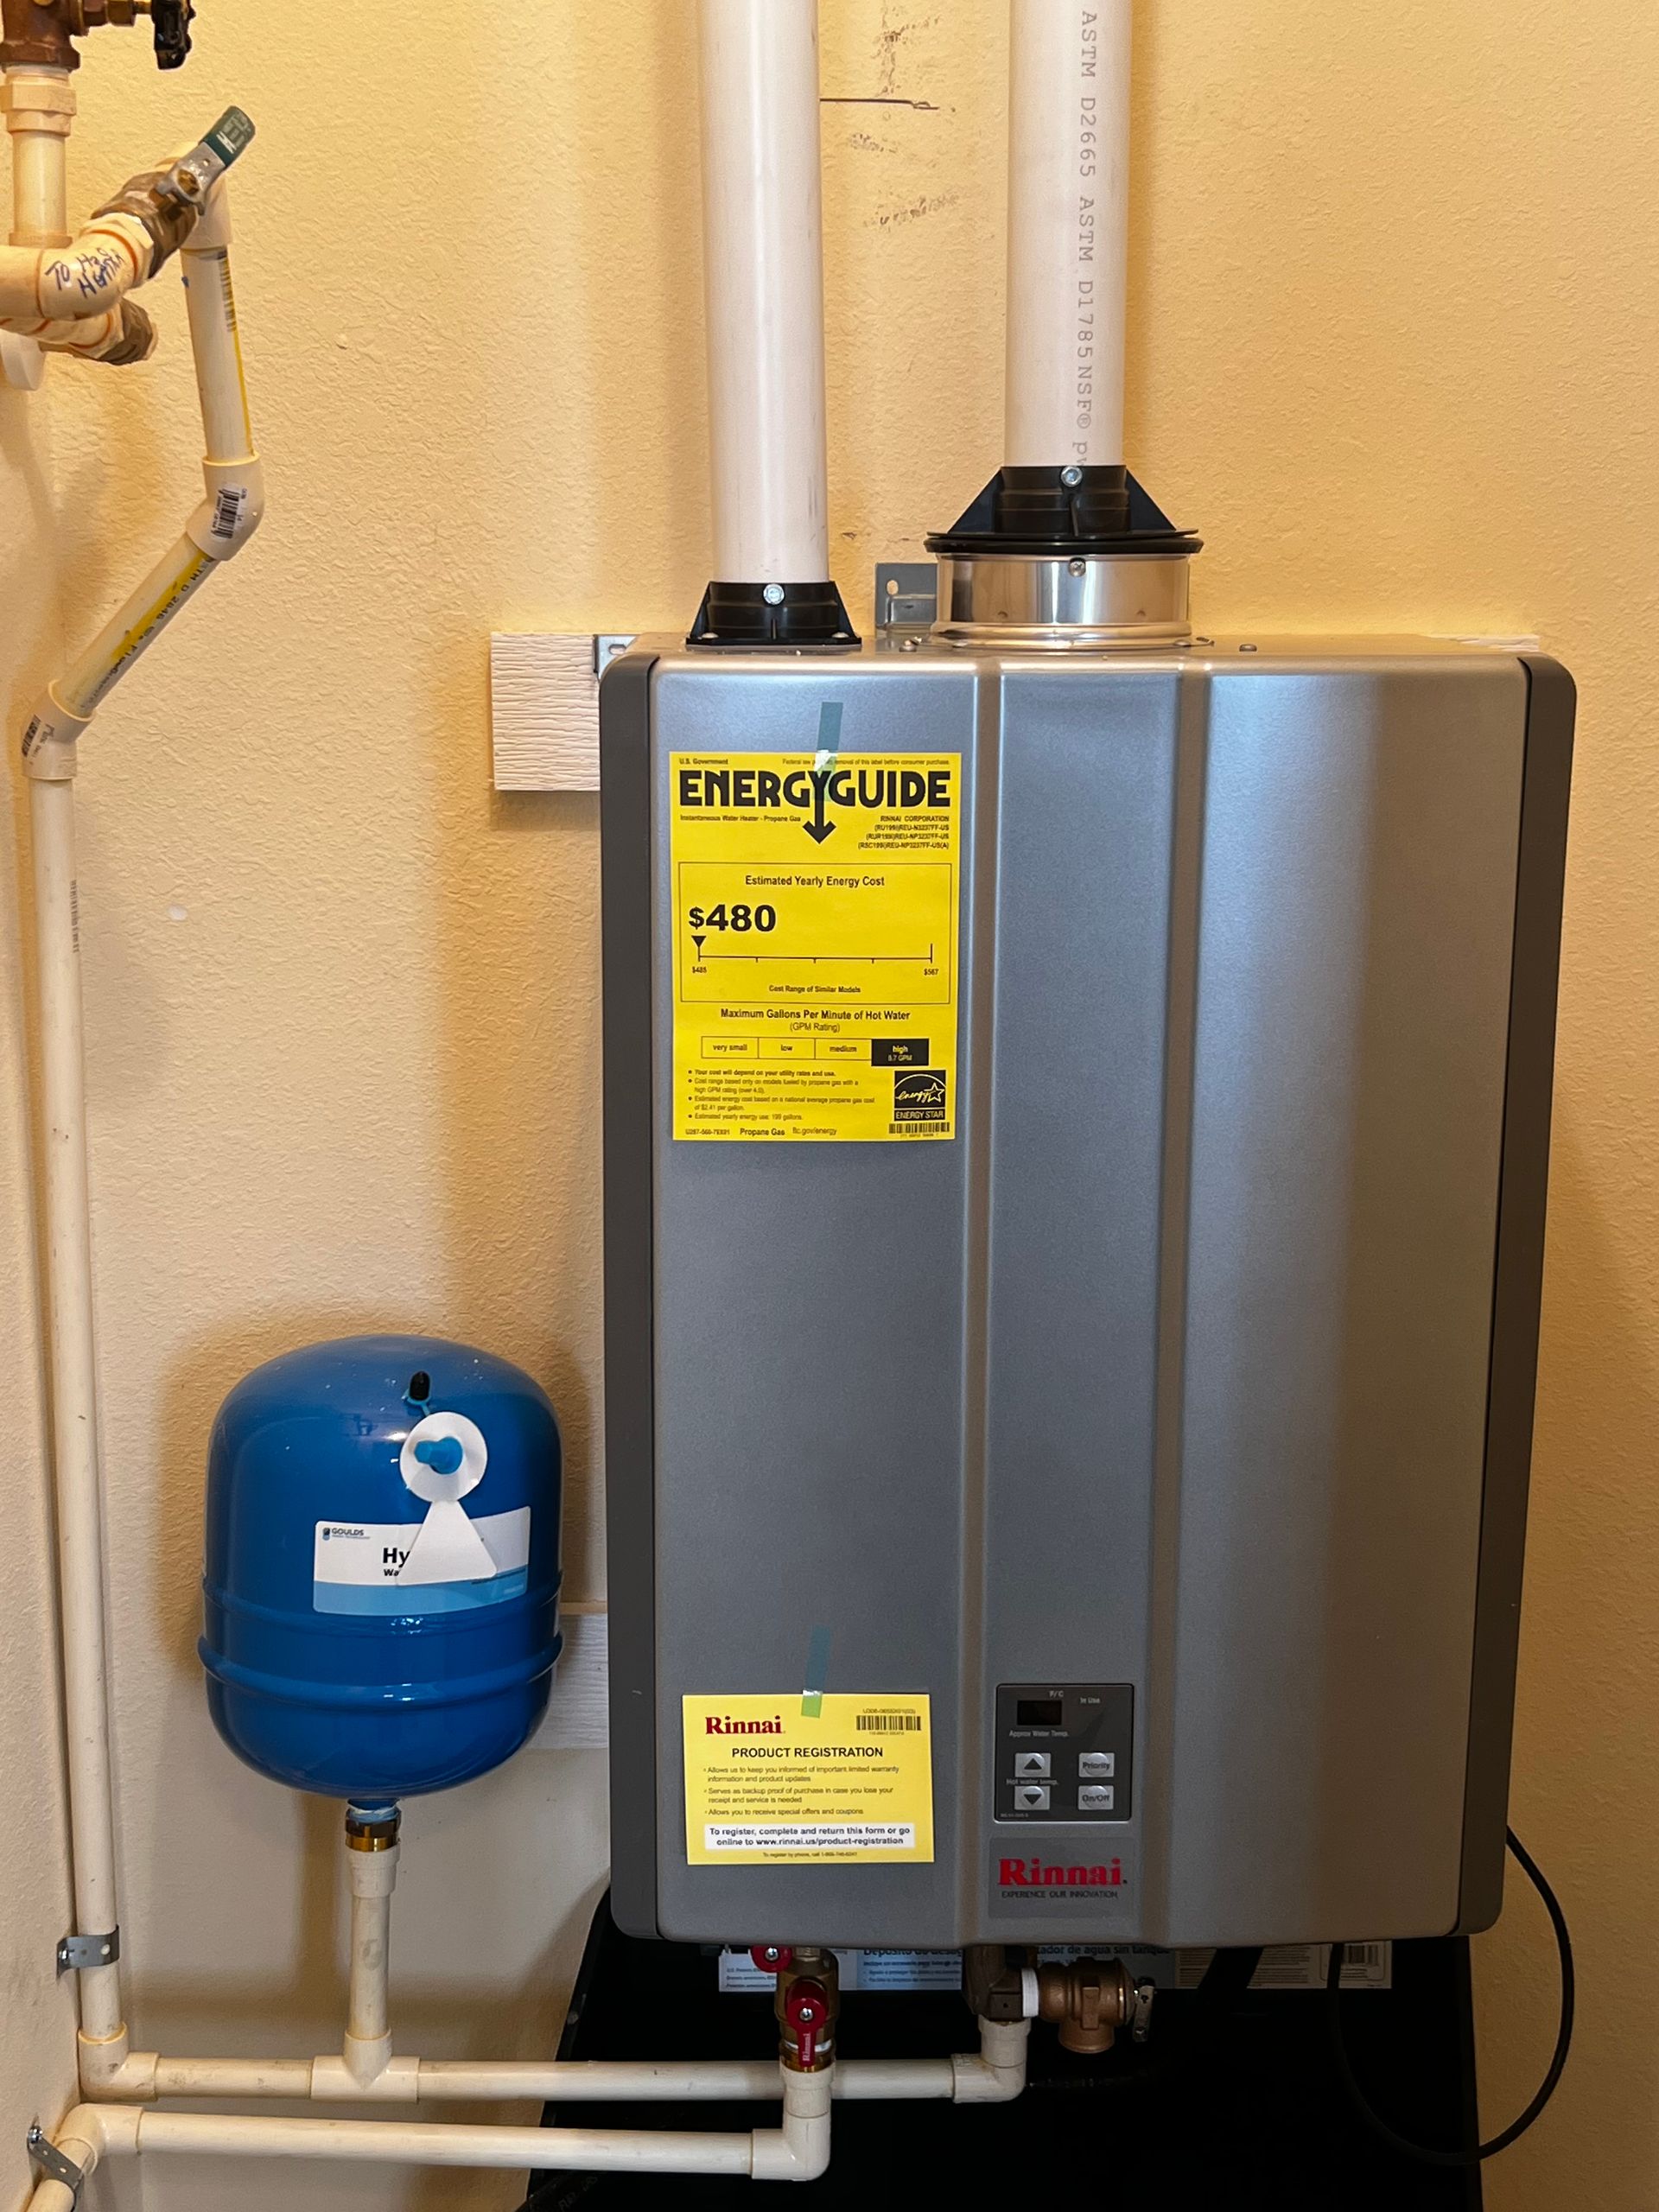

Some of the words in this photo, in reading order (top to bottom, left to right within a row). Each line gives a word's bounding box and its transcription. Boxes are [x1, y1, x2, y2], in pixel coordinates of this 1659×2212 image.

[1080, 10, 1097, 78] ASTM
[1079, 97, 1097, 177] D2665
[1078, 196, 1095, 262] ASTM
[679, 770, 950, 808] ENERGYGUIDE
[746, 875, 792, 886] Estimated
[795, 876, 823, 888] Yearly
[827, 876, 860, 888] Energy
[862, 876, 885, 889] Cost
[689, 904, 777, 932] $480
[766, 1009, 801, 1018] Gallons
[804, 1009, 818, 1019] Per
[821, 1010, 851, 1019] Minute
[854, 1010, 863, 1020] of
[866, 1011, 881, 1020] Hot
[884, 1011, 910, 1020] Water
[790, 1022, 811, 1031] (GPM
[813, 1022, 840, 1033] Rating)
[780, 1044, 793, 1052] low
[893, 1046, 908, 1054] high
[705, 1715, 782, 1735] Rinnai
[732, 1748, 789, 1758] PRODUCT
[794, 1747, 883, 1758] REGISTRATION
[1082, 1761, 1110, 1771] Priority
[1082, 1795, 1109, 1803] On/Off
[1049, 1890, 1066, 1898] OUR
[1070, 1890, 1118, 1898] INNOVATION
